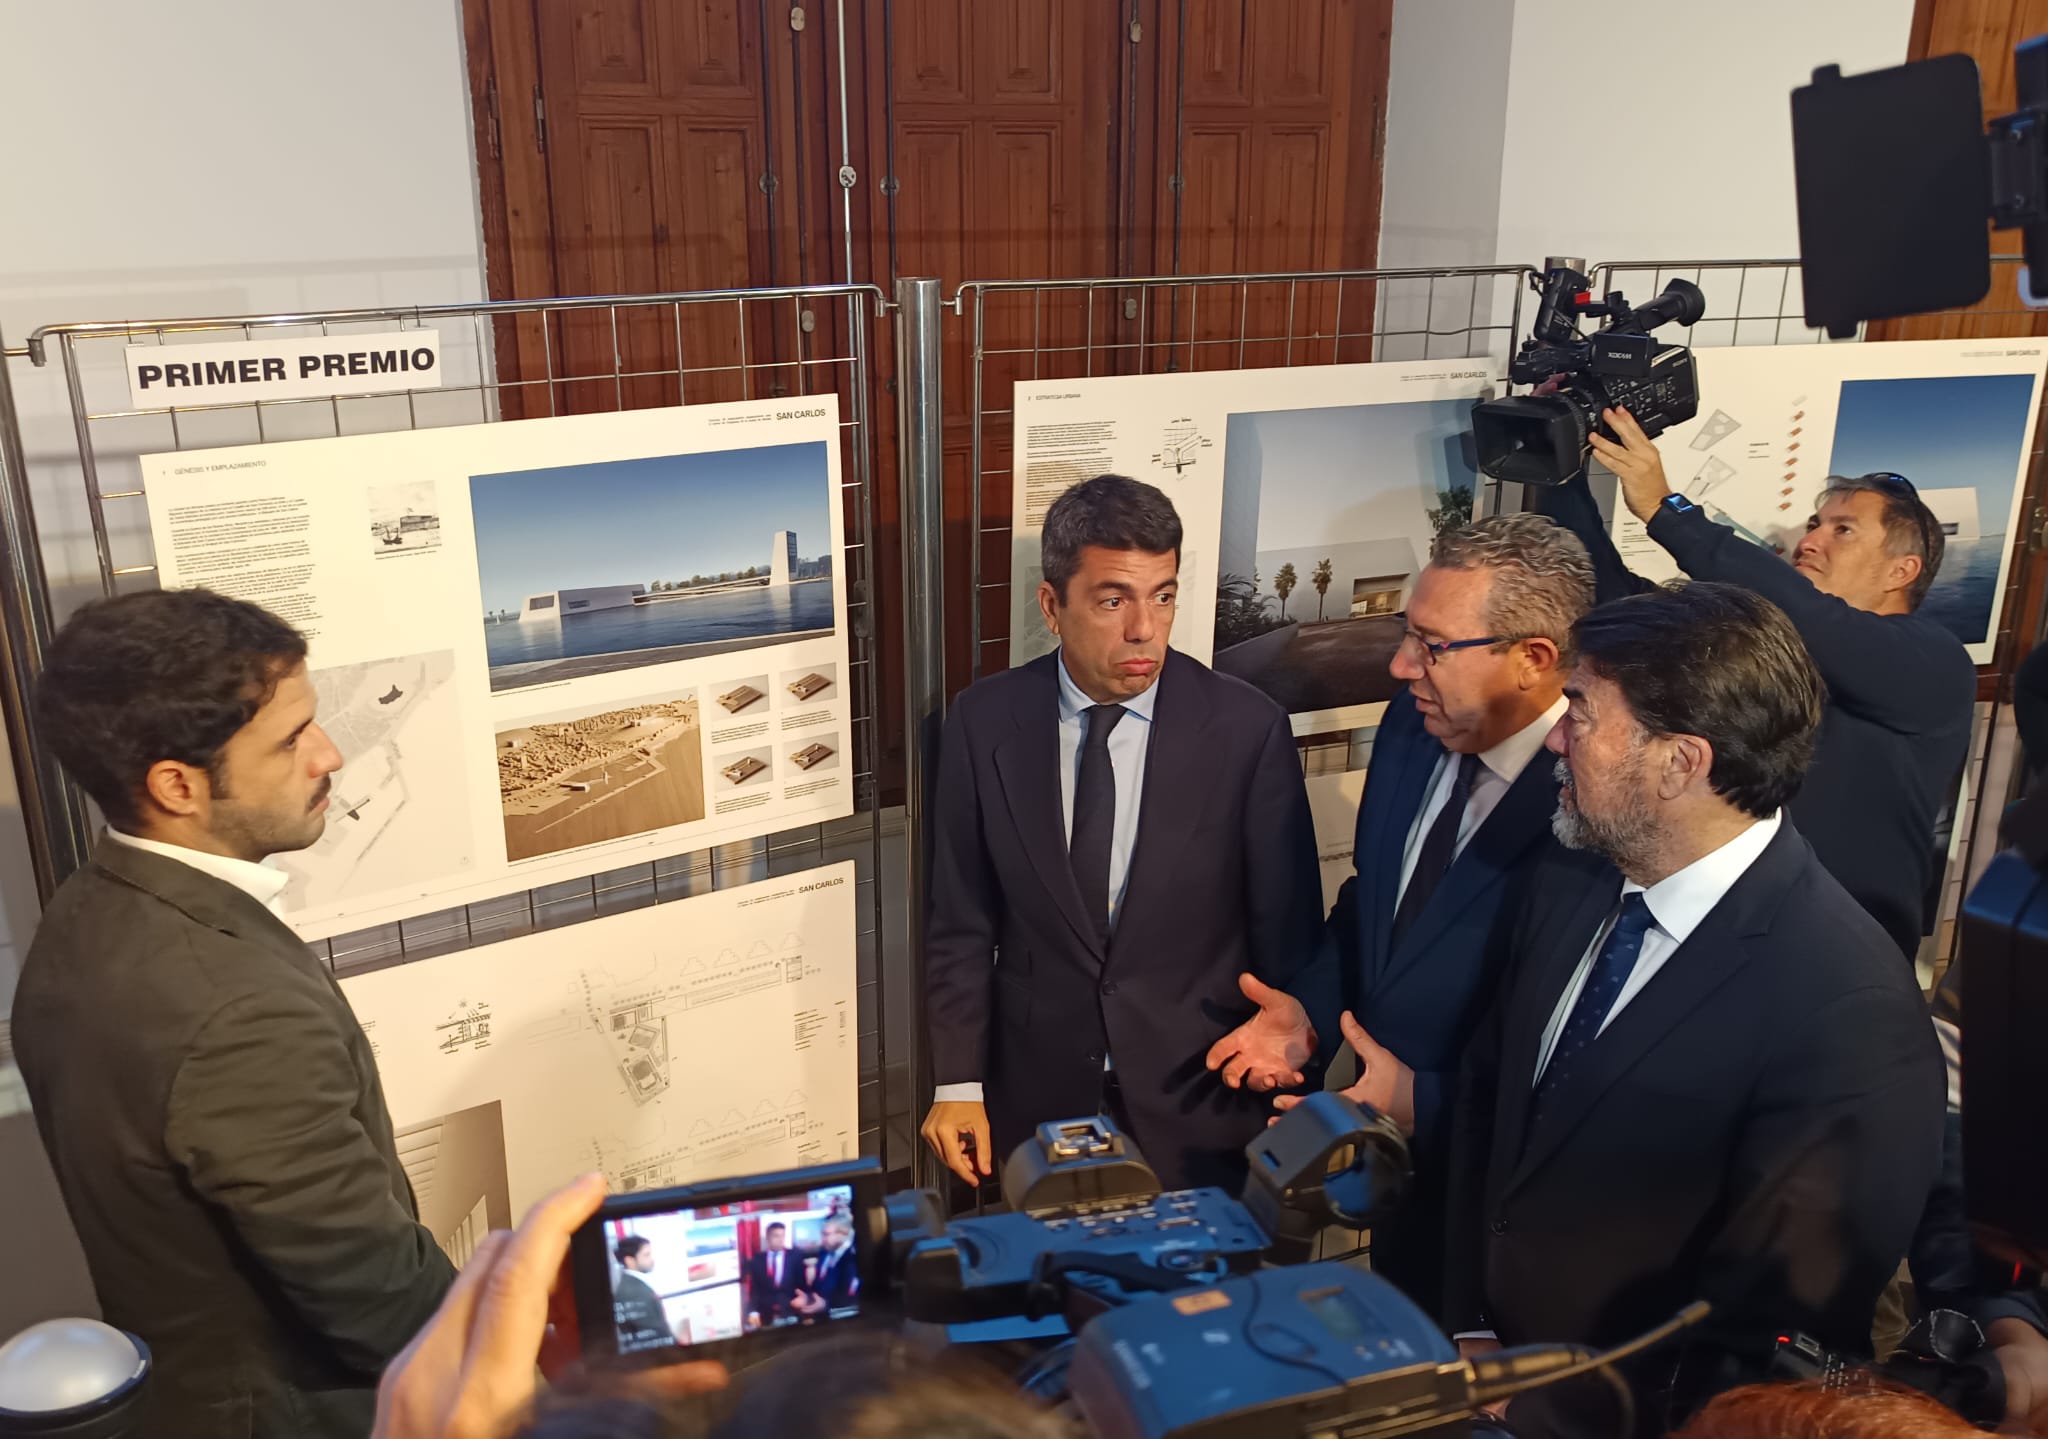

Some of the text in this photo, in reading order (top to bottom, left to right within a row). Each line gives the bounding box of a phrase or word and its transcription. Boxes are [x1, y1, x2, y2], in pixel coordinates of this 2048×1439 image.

[138, 347, 435, 390] PRIMER PREMIO
[1450, 372, 1463, 380] SAN
[1463, 371, 1487, 379] CARLOS
[776, 411, 794, 421] SAN
[794, 408, 826, 419] CARLOS
[798, 877, 845, 894] SAN CARLOS
